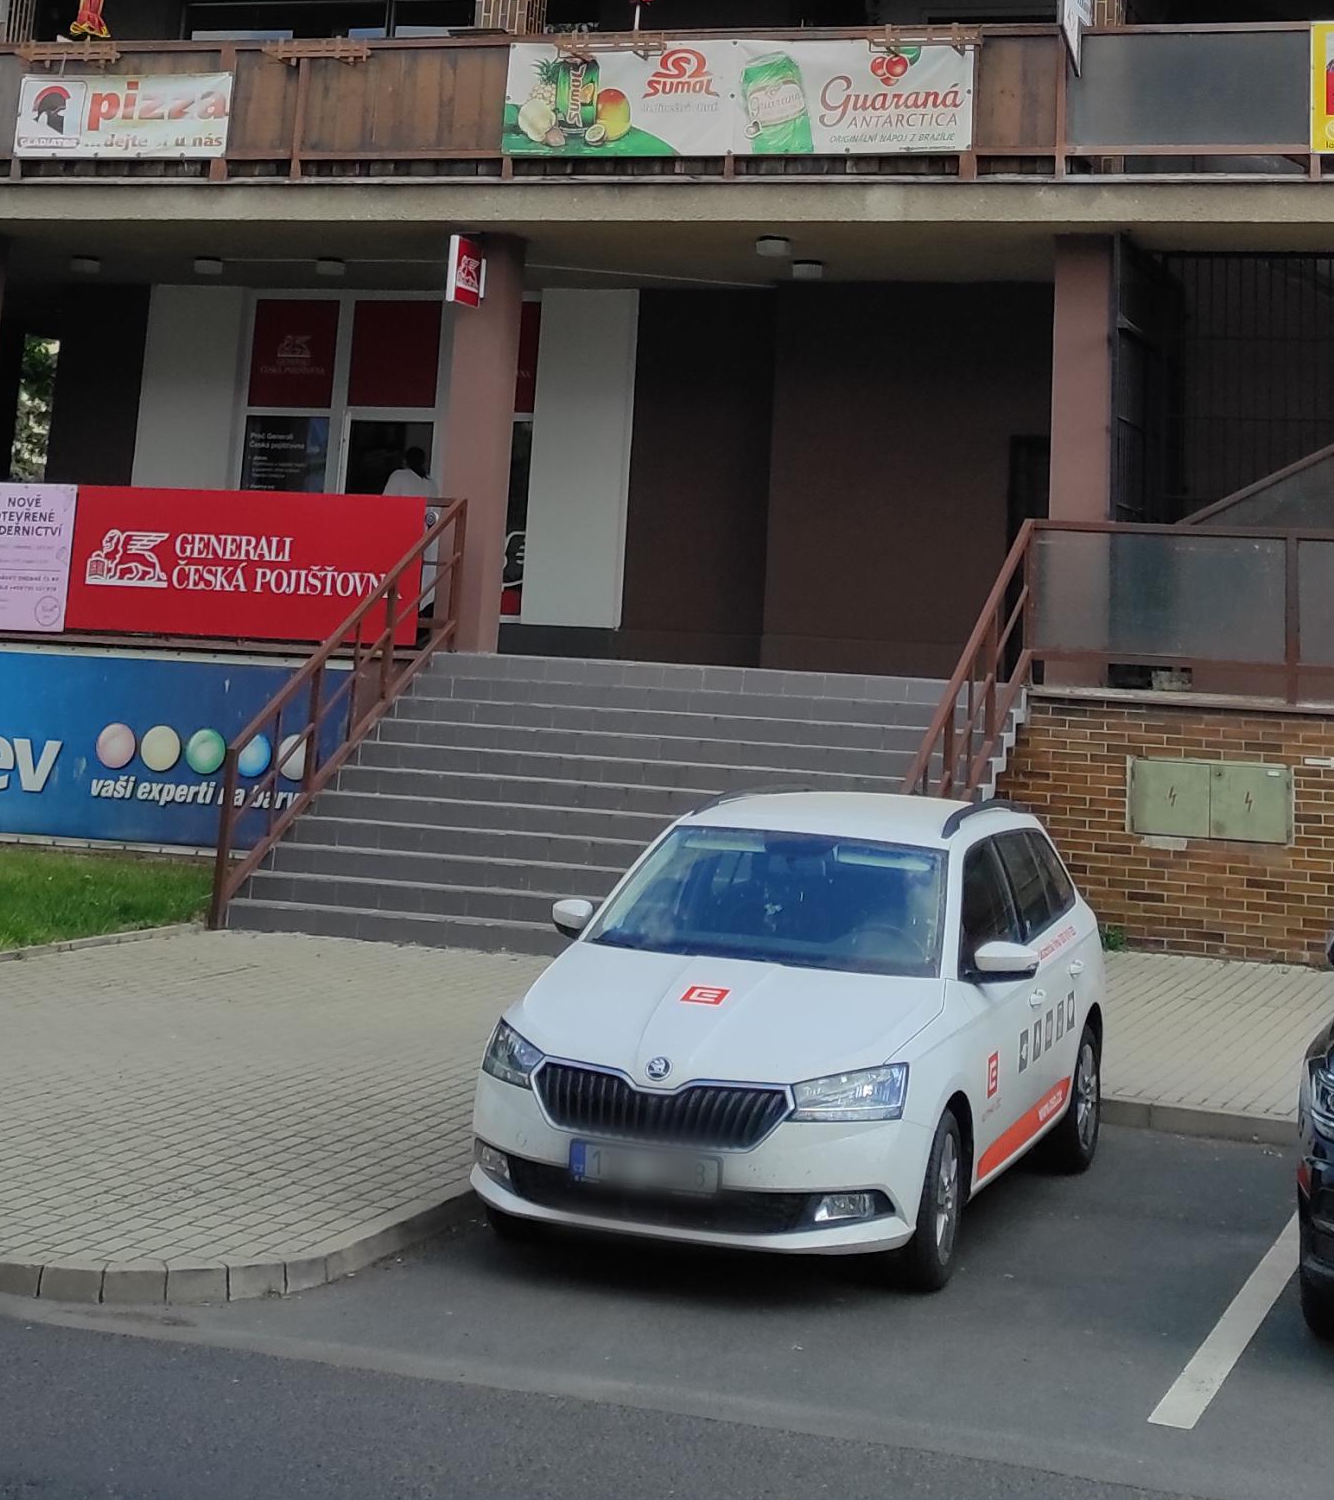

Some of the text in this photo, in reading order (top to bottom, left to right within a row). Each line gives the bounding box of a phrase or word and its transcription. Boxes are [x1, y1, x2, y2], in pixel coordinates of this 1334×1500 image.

[87, 81, 229, 132] pizza
[819, 75, 965, 128] Guaraná
[847, 112, 958, 129] ANTARCTICA
[175, 135, 185, 148] u
[192, 133, 223, 148] nás
[175, 533, 293, 562] GENERALI
[172, 560, 402, 599] ČESKÁ POJIŠŤOVN
[90, 775, 134, 798] vaši
[137, 781, 216, 807] experti
